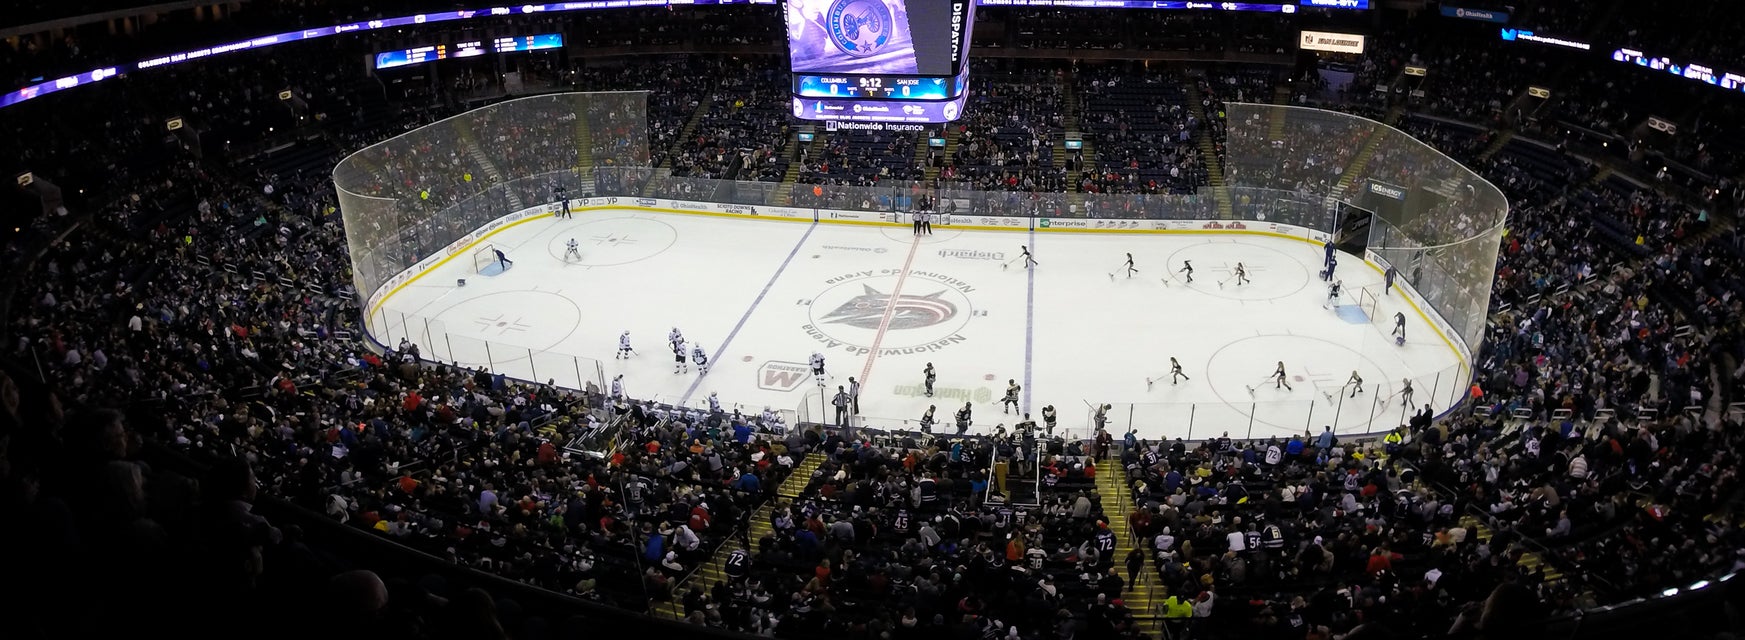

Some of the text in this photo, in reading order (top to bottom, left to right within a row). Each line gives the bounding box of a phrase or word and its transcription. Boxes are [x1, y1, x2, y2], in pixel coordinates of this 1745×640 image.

[831, 1, 848, 45] COLUMBUS
[859, 77, 882, 87] 9:12
[830, 84, 838, 95] 0
[902, 86, 910, 97] 0
[838, 121, 924, 132] Nationwide Insurance
[578, 198, 589, 206] yp
[606, 197, 618, 205] yp
[938, 249, 1005, 260] Dispatch
[825, 268, 976, 294] Nationwide Arena
[802, 323, 967, 358] Nationwide Arena
[767, 363, 808, 373] MARATHON
[764, 370, 803, 388] M
[1147, 454, 1157, 464] 31
[1267, 449, 1278, 459] 72
[894, 517, 908, 529] 45
[1100, 539, 1113, 551] 72
[729, 554, 744, 566] 72
[1029, 558, 1043, 569] 38
